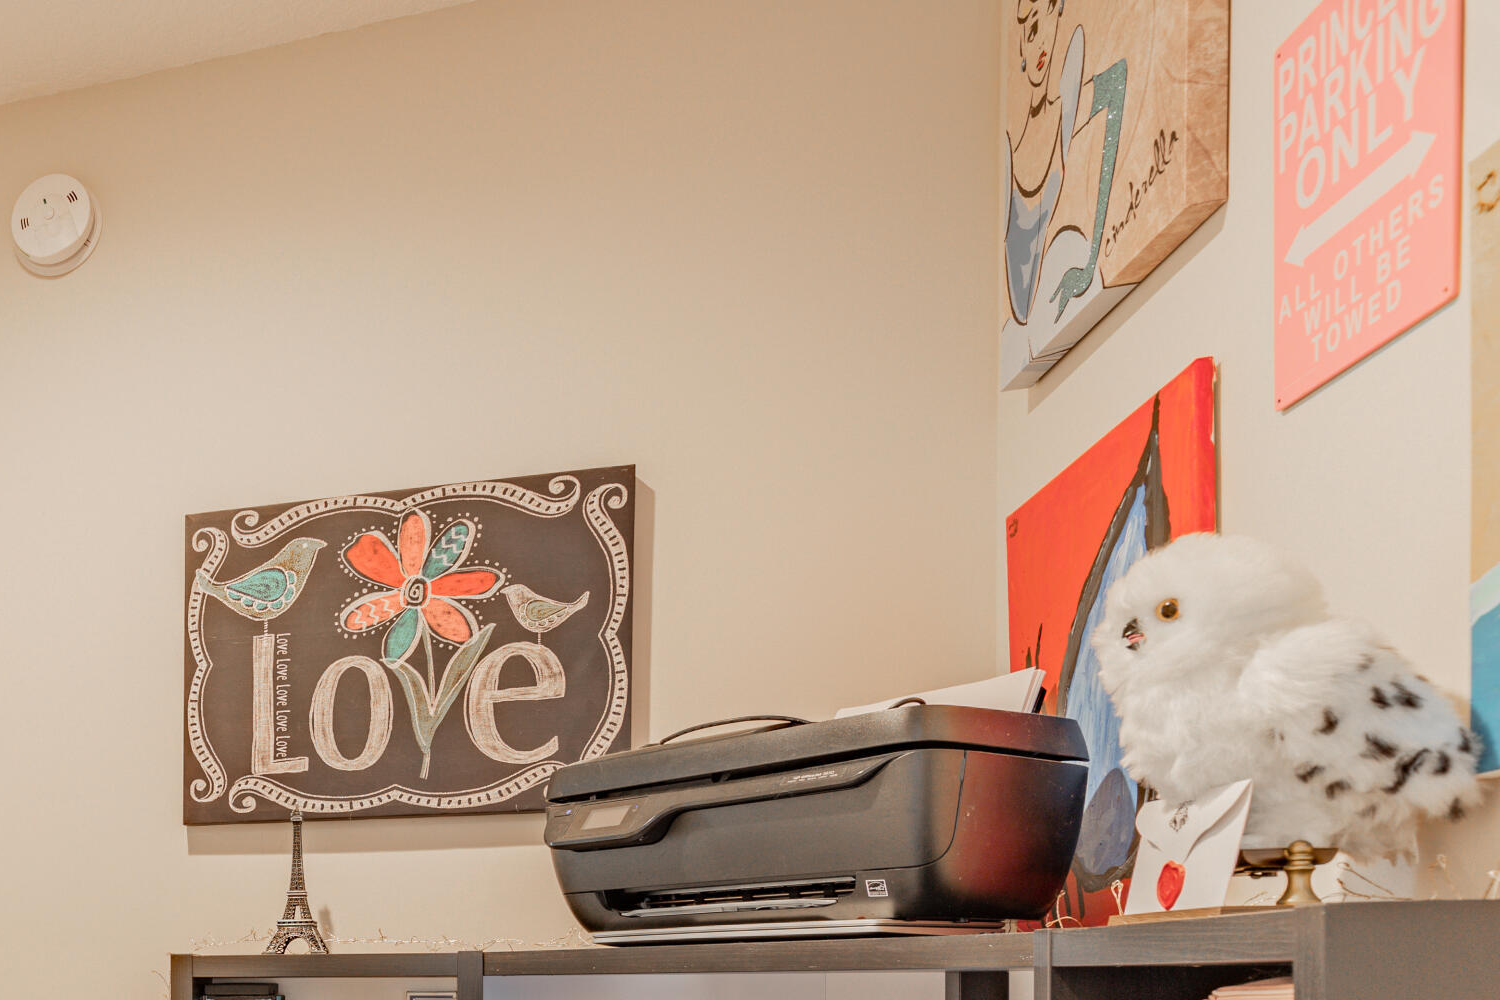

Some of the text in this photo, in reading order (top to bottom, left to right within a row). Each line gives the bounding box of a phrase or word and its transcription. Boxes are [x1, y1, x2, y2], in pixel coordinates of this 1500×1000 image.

[1279, 0, 1446, 172] PARKING
[1296, 44, 1426, 209] ONLY
[1104, 128, 1179, 257] cinderella
[1278, 174, 1445, 325] ALL OTHERS
[1304, 236, 1411, 336] WILL BE
[1311, 279, 1402, 362] TOWED
[251, 625, 566, 779] Love
[276, 632, 292, 758] Love Love Love Love Love
